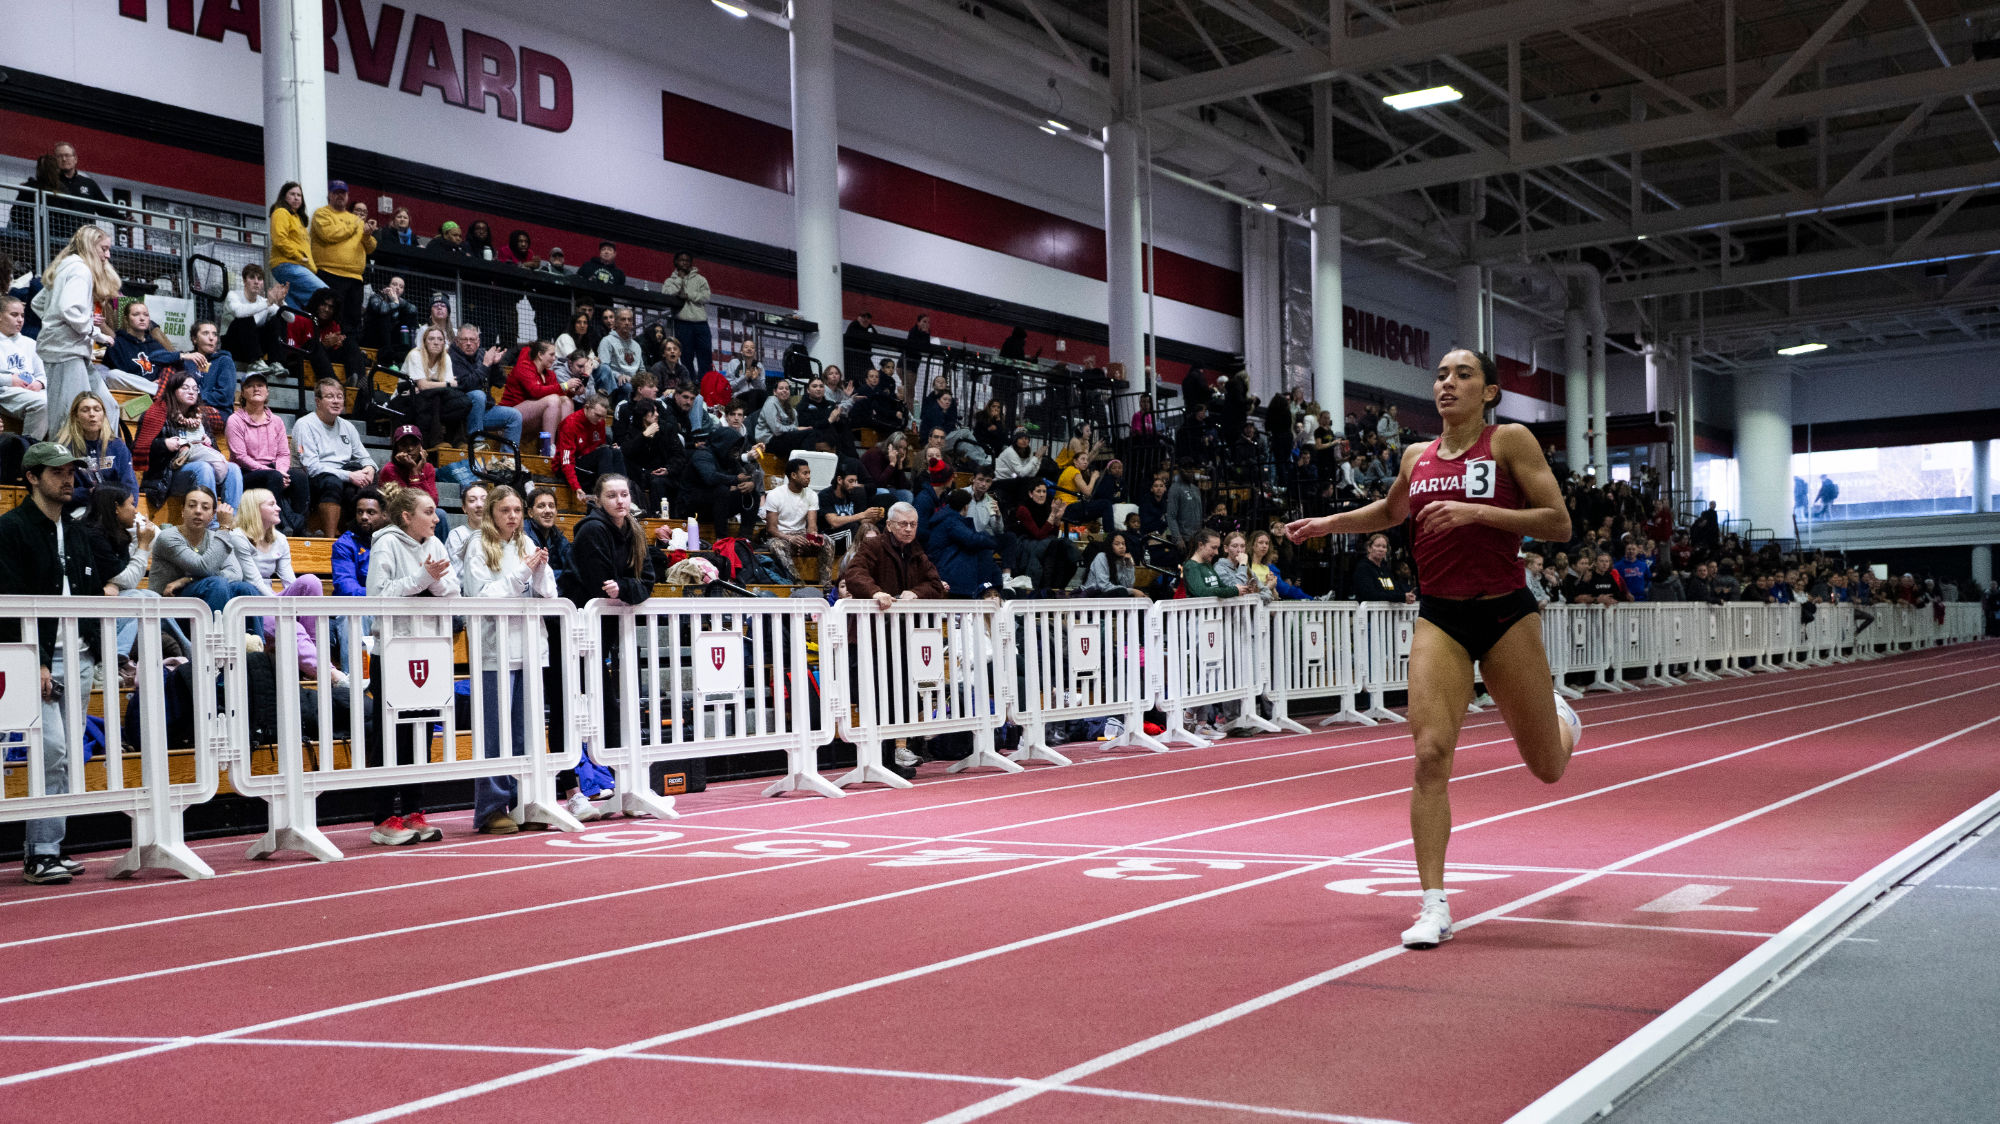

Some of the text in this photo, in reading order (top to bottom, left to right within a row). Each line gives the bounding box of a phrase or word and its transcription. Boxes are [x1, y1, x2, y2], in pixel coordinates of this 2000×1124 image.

[119, 0, 574, 133] VARD
[164, 322, 185, 336] BREAD
[1342, 304, 1430, 371] RIMSON
[54, 444, 68, 454] D
[1409, 474, 1467, 497] HARVA
[1472, 462, 1489, 495] 3
[714, 649, 723, 664] H
[924, 648, 929, 661] H
[413, 662, 424, 680] H
[1083, 859, 1245, 880] 3
[1325, 868, 1508, 897] 2
[1633, 884, 1758, 912] 1
